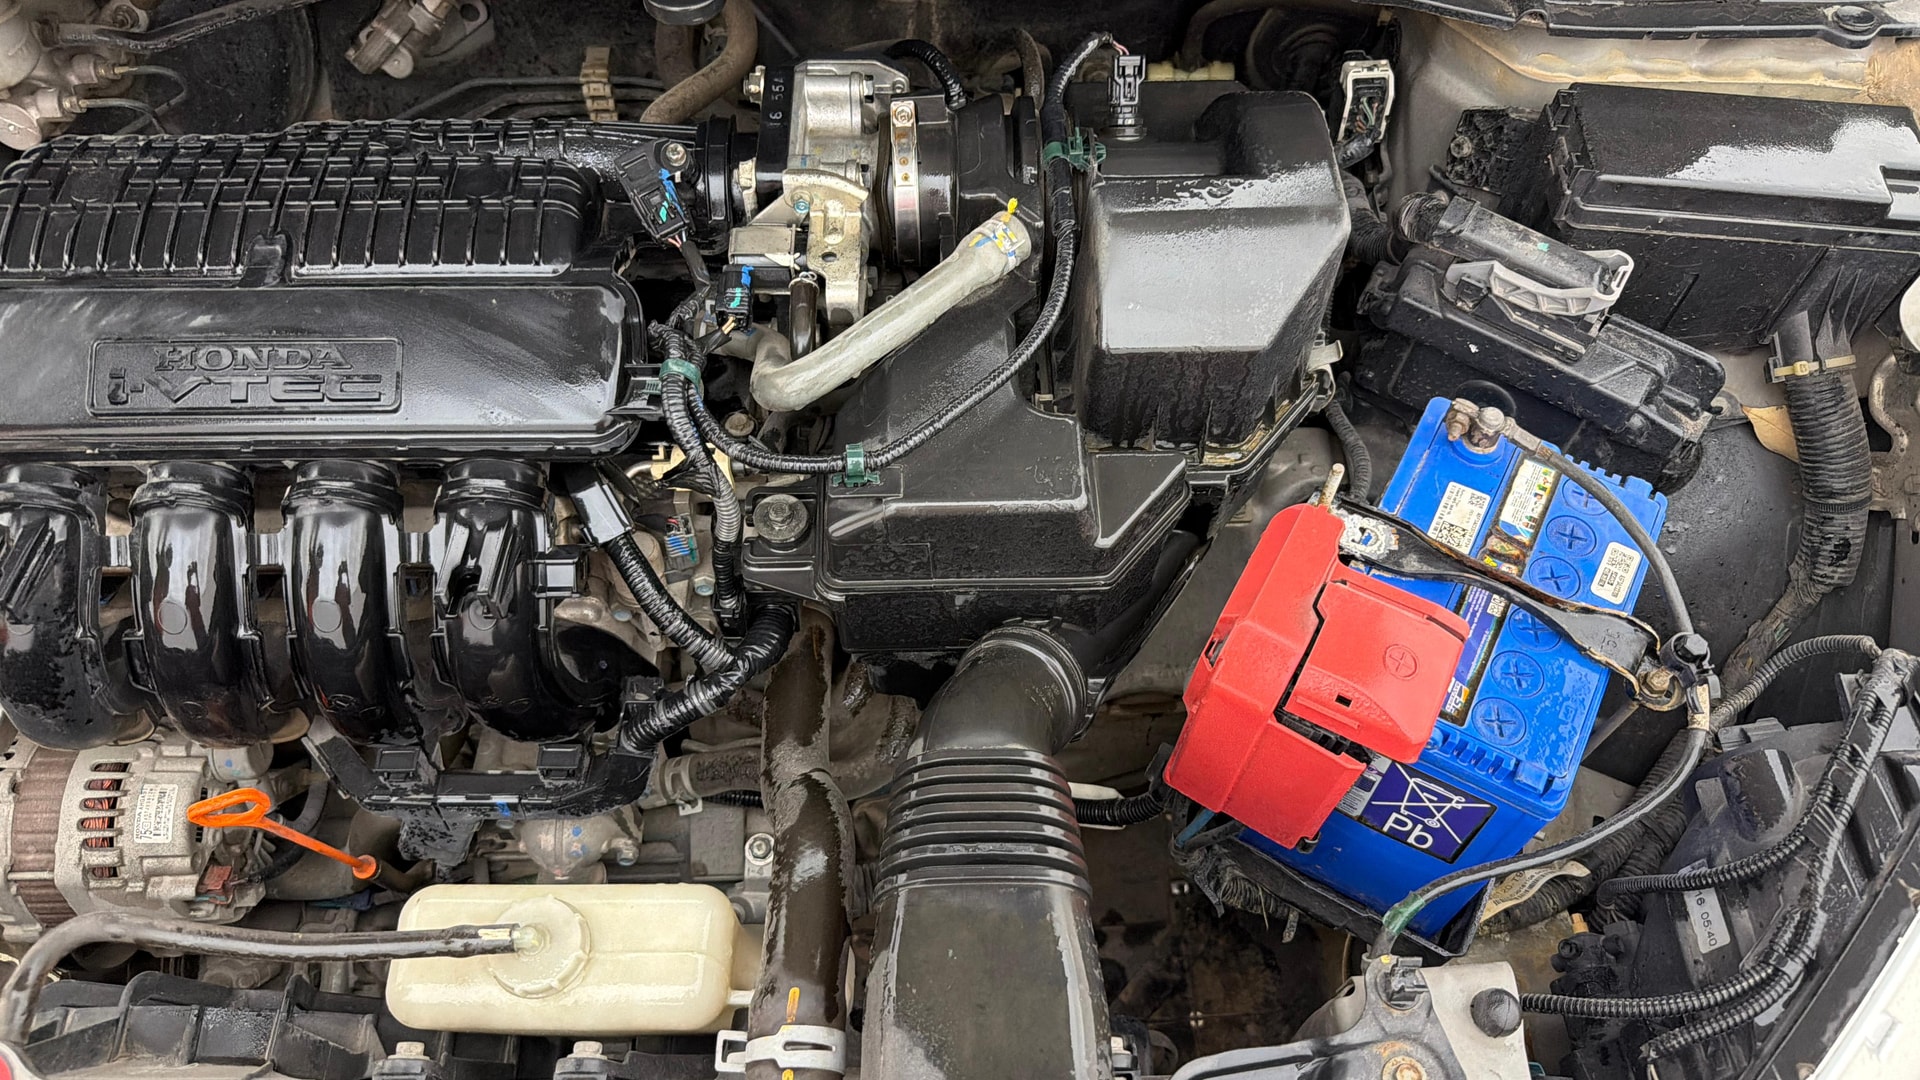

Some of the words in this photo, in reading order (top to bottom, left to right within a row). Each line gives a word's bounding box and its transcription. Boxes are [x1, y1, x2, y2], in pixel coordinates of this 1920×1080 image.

[154, 346, 354, 371] HONDA
[107, 367, 382, 405] i-VTEC
[1382, 812, 1433, 849] Pb
[1701, 911, 1718, 947] 05:40
